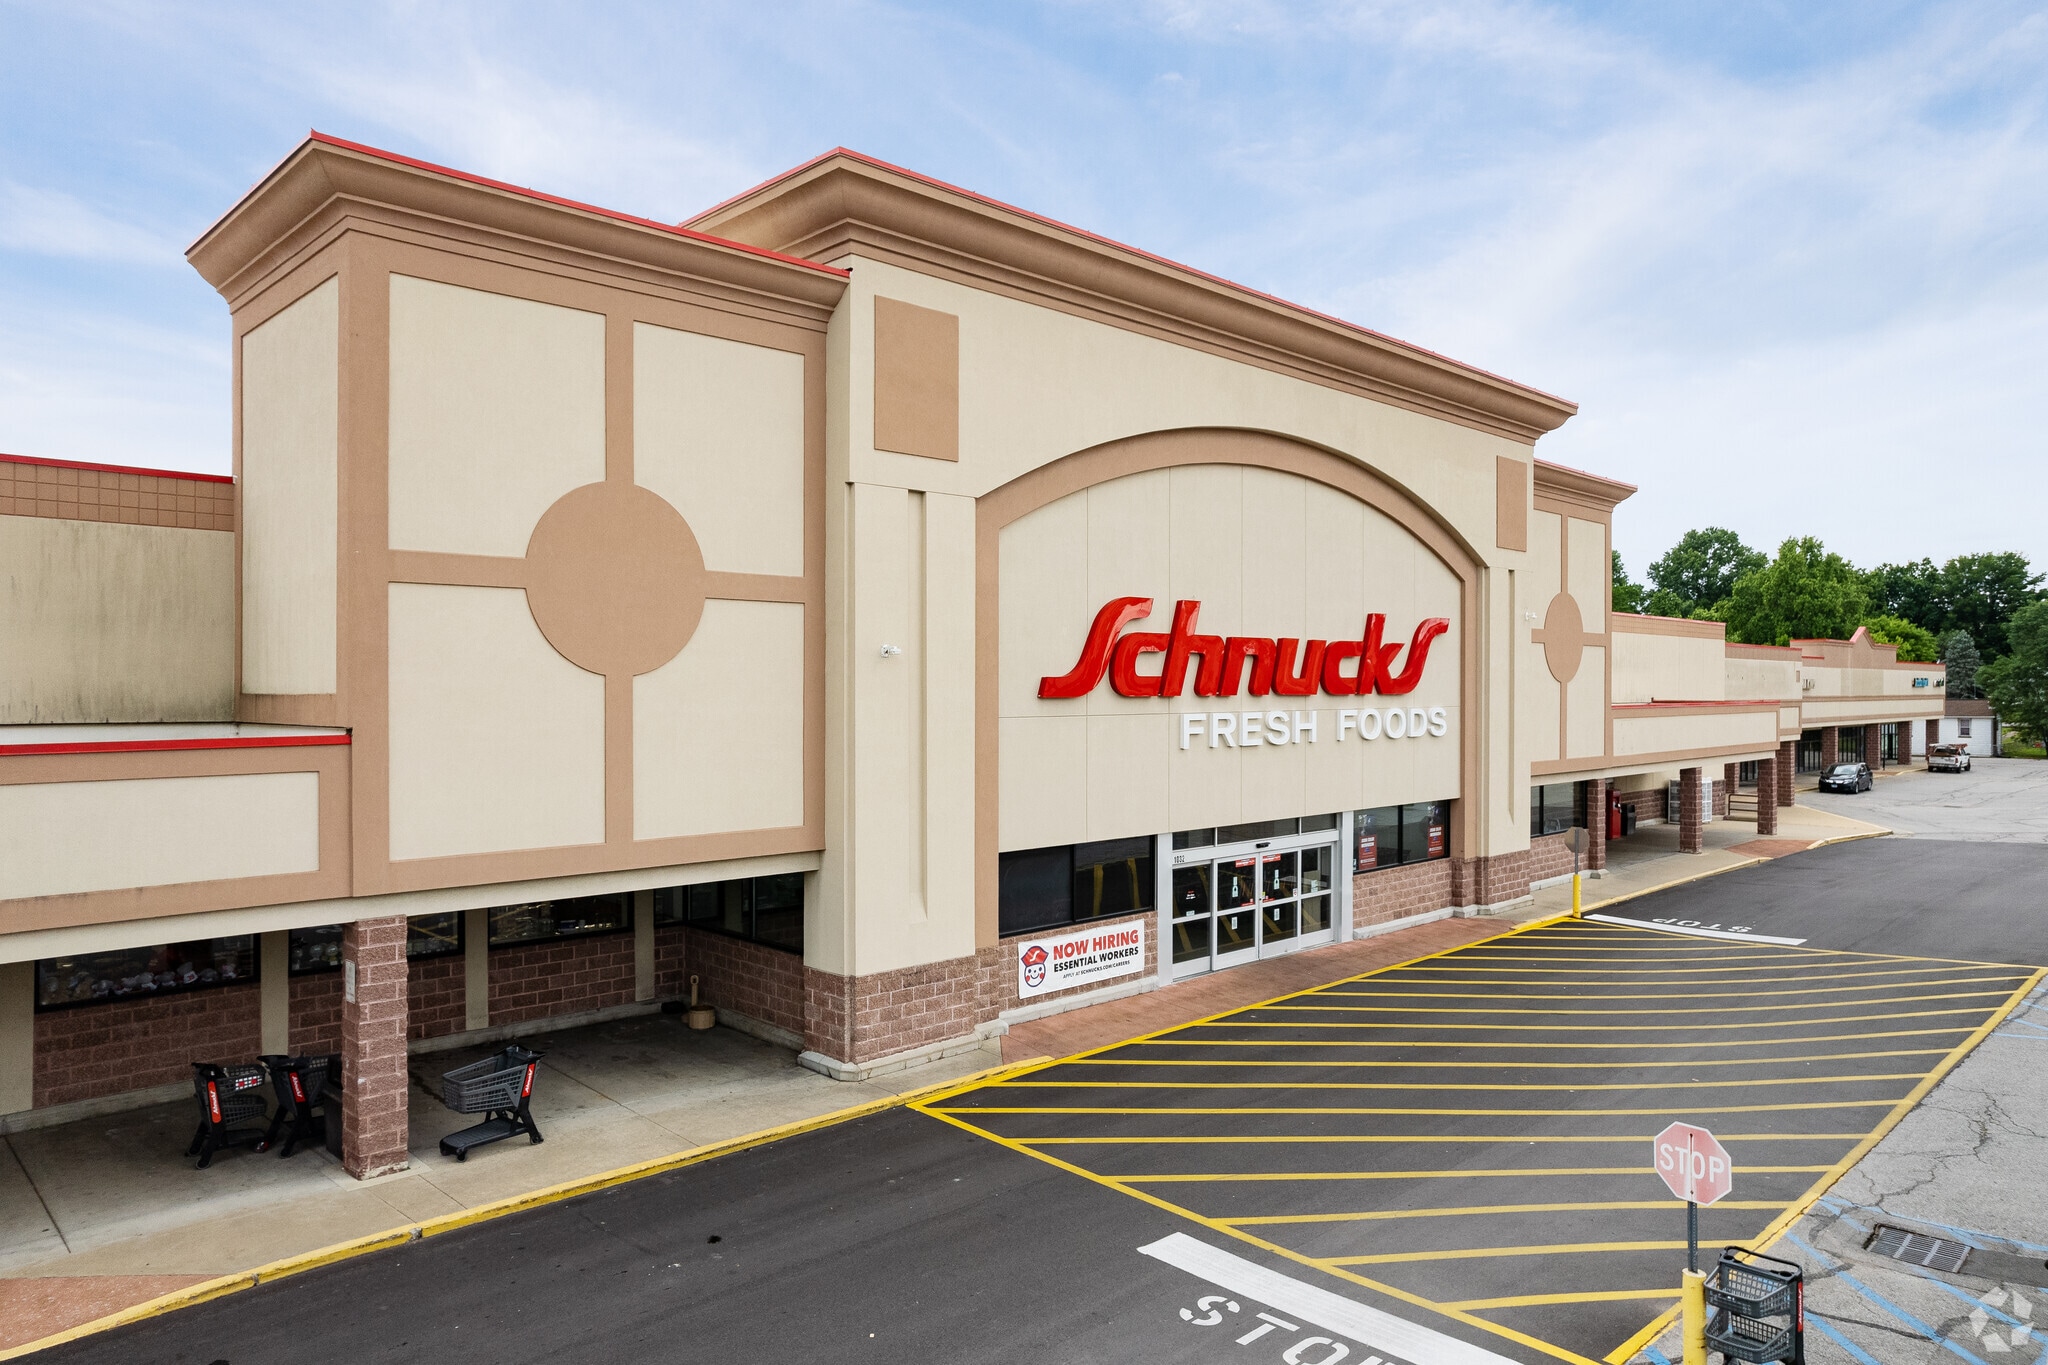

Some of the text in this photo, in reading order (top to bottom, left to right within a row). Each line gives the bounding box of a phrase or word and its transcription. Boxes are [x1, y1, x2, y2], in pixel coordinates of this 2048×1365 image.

[1037, 596, 1450, 699] Schnucks
[1179, 707, 1448, 750] FRESH FOODS
[1652, 918, 1752, 933] STOP
[1053, 929, 1139, 960] NOW HIRING
[1054, 946, 1139, 973] ESSENTIAL WORKERS
[1659, 1143, 1725, 1183] STOP
